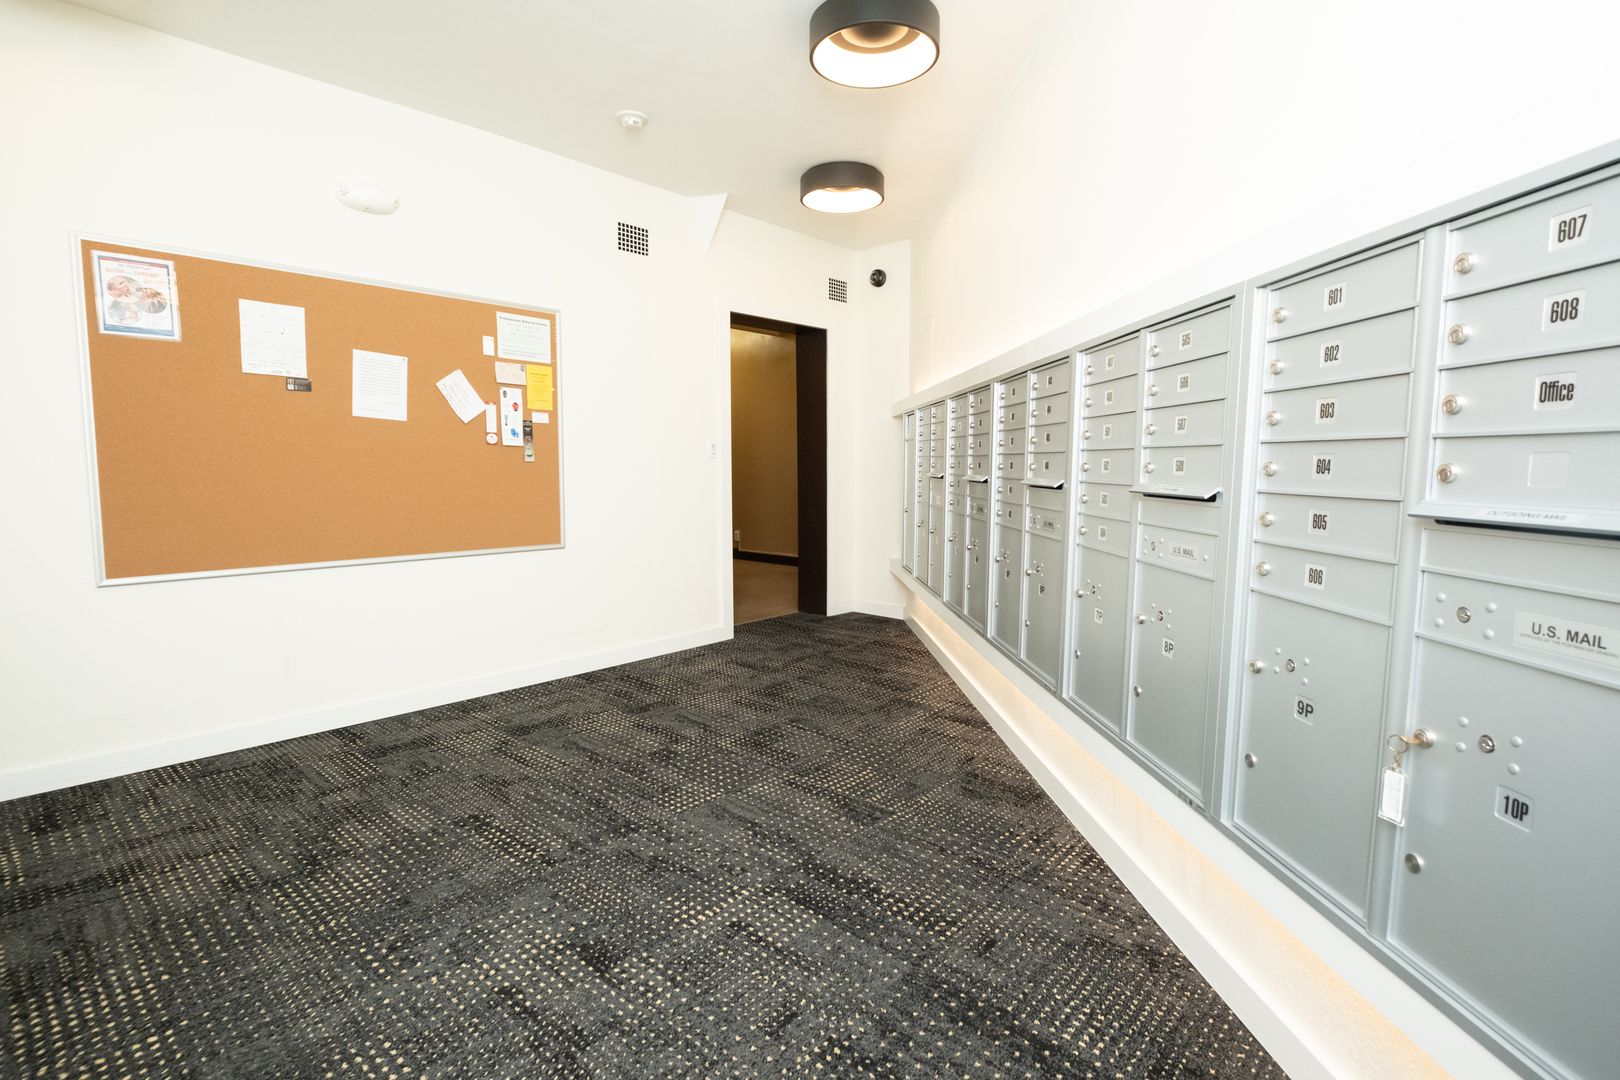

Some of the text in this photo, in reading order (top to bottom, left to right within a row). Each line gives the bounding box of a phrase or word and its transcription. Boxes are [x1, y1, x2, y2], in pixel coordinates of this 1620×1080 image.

[1557, 213, 1587, 243] 607
[1328, 287, 1343, 306] 601
[1550, 296, 1579, 324] 608
[1324, 345, 1340, 363] 602
[1538, 380, 1575, 405] Office
[1320, 402, 1335, 419] 603
[1316, 458, 1331, 475] 604
[1312, 513, 1327, 530] 605
[1487, 510, 1542, 520] OUTGOING
[1308, 568, 1323, 586] 606
[1531, 622, 1608, 650] U.S. MAIL
[1163, 640, 1174, 654] 8P
[1297, 699, 1314, 718] 9P
[1503, 794, 1529, 822] 10P
